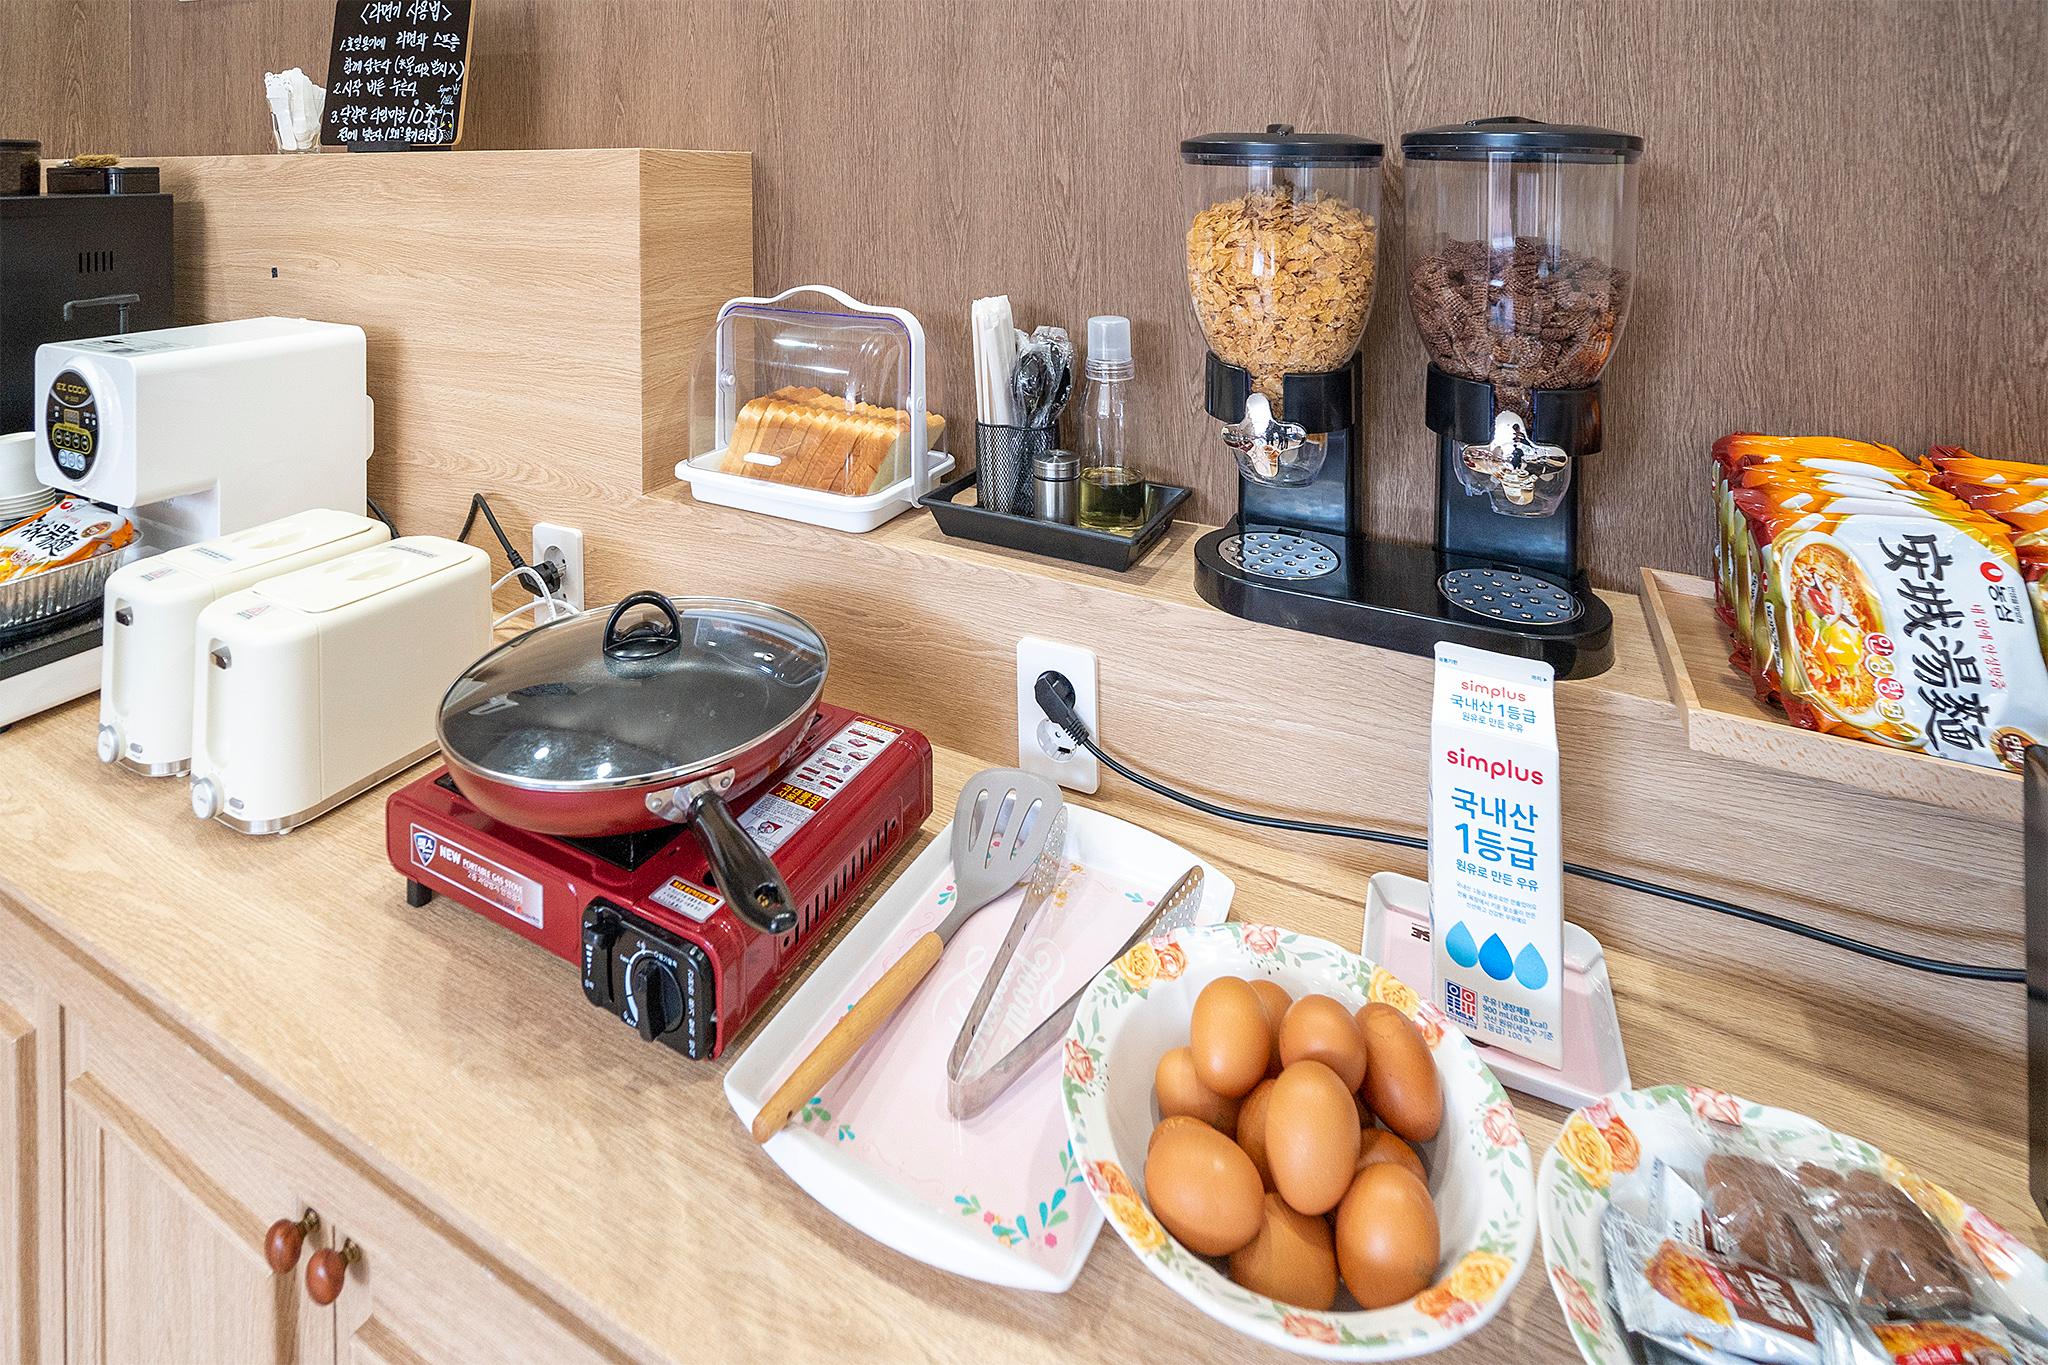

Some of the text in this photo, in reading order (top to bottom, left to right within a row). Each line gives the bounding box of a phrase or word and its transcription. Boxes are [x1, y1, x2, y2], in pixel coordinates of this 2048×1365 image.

[395, 30, 429, 52] 라면과
[343, 56, 362, 75] 함께
[332, 77, 363, 98] 2.시작
[366, 76, 386, 97] 버튼
[337, 127, 358, 142] 전에
[56, 382, 88, 395] EZ COOK
[1988, 584, 2015, 624] 농심
[1878, 533, 1990, 751] 安城湯麵
[1970, 604, 2007, 689] 내 입에 안성맞춤
[1461, 680, 1527, 702] simplus
[1866, 634, 1904, 722] 안성탕면
[1450, 693, 1536, 724] 국내산 1등급
[1462, 712, 1524, 733] 원유로 만든 우유
[1447, 747, 1544, 785] simplus
[1451, 787, 1539, 834] 국내산
[1455, 823, 1538, 871] 1등급
[439, 844, 462, 865] NEW
[491, 871, 505, 886] GAS
[1455, 859, 1539, 892] 원유로 만든 우유
[1482, 1005, 1498, 1015] 900
[1529, 1018, 1548, 1030] kcal)
[1483, 1022, 1506, 1036] 1등급)
[1507, 1029, 1523, 1040] 100
